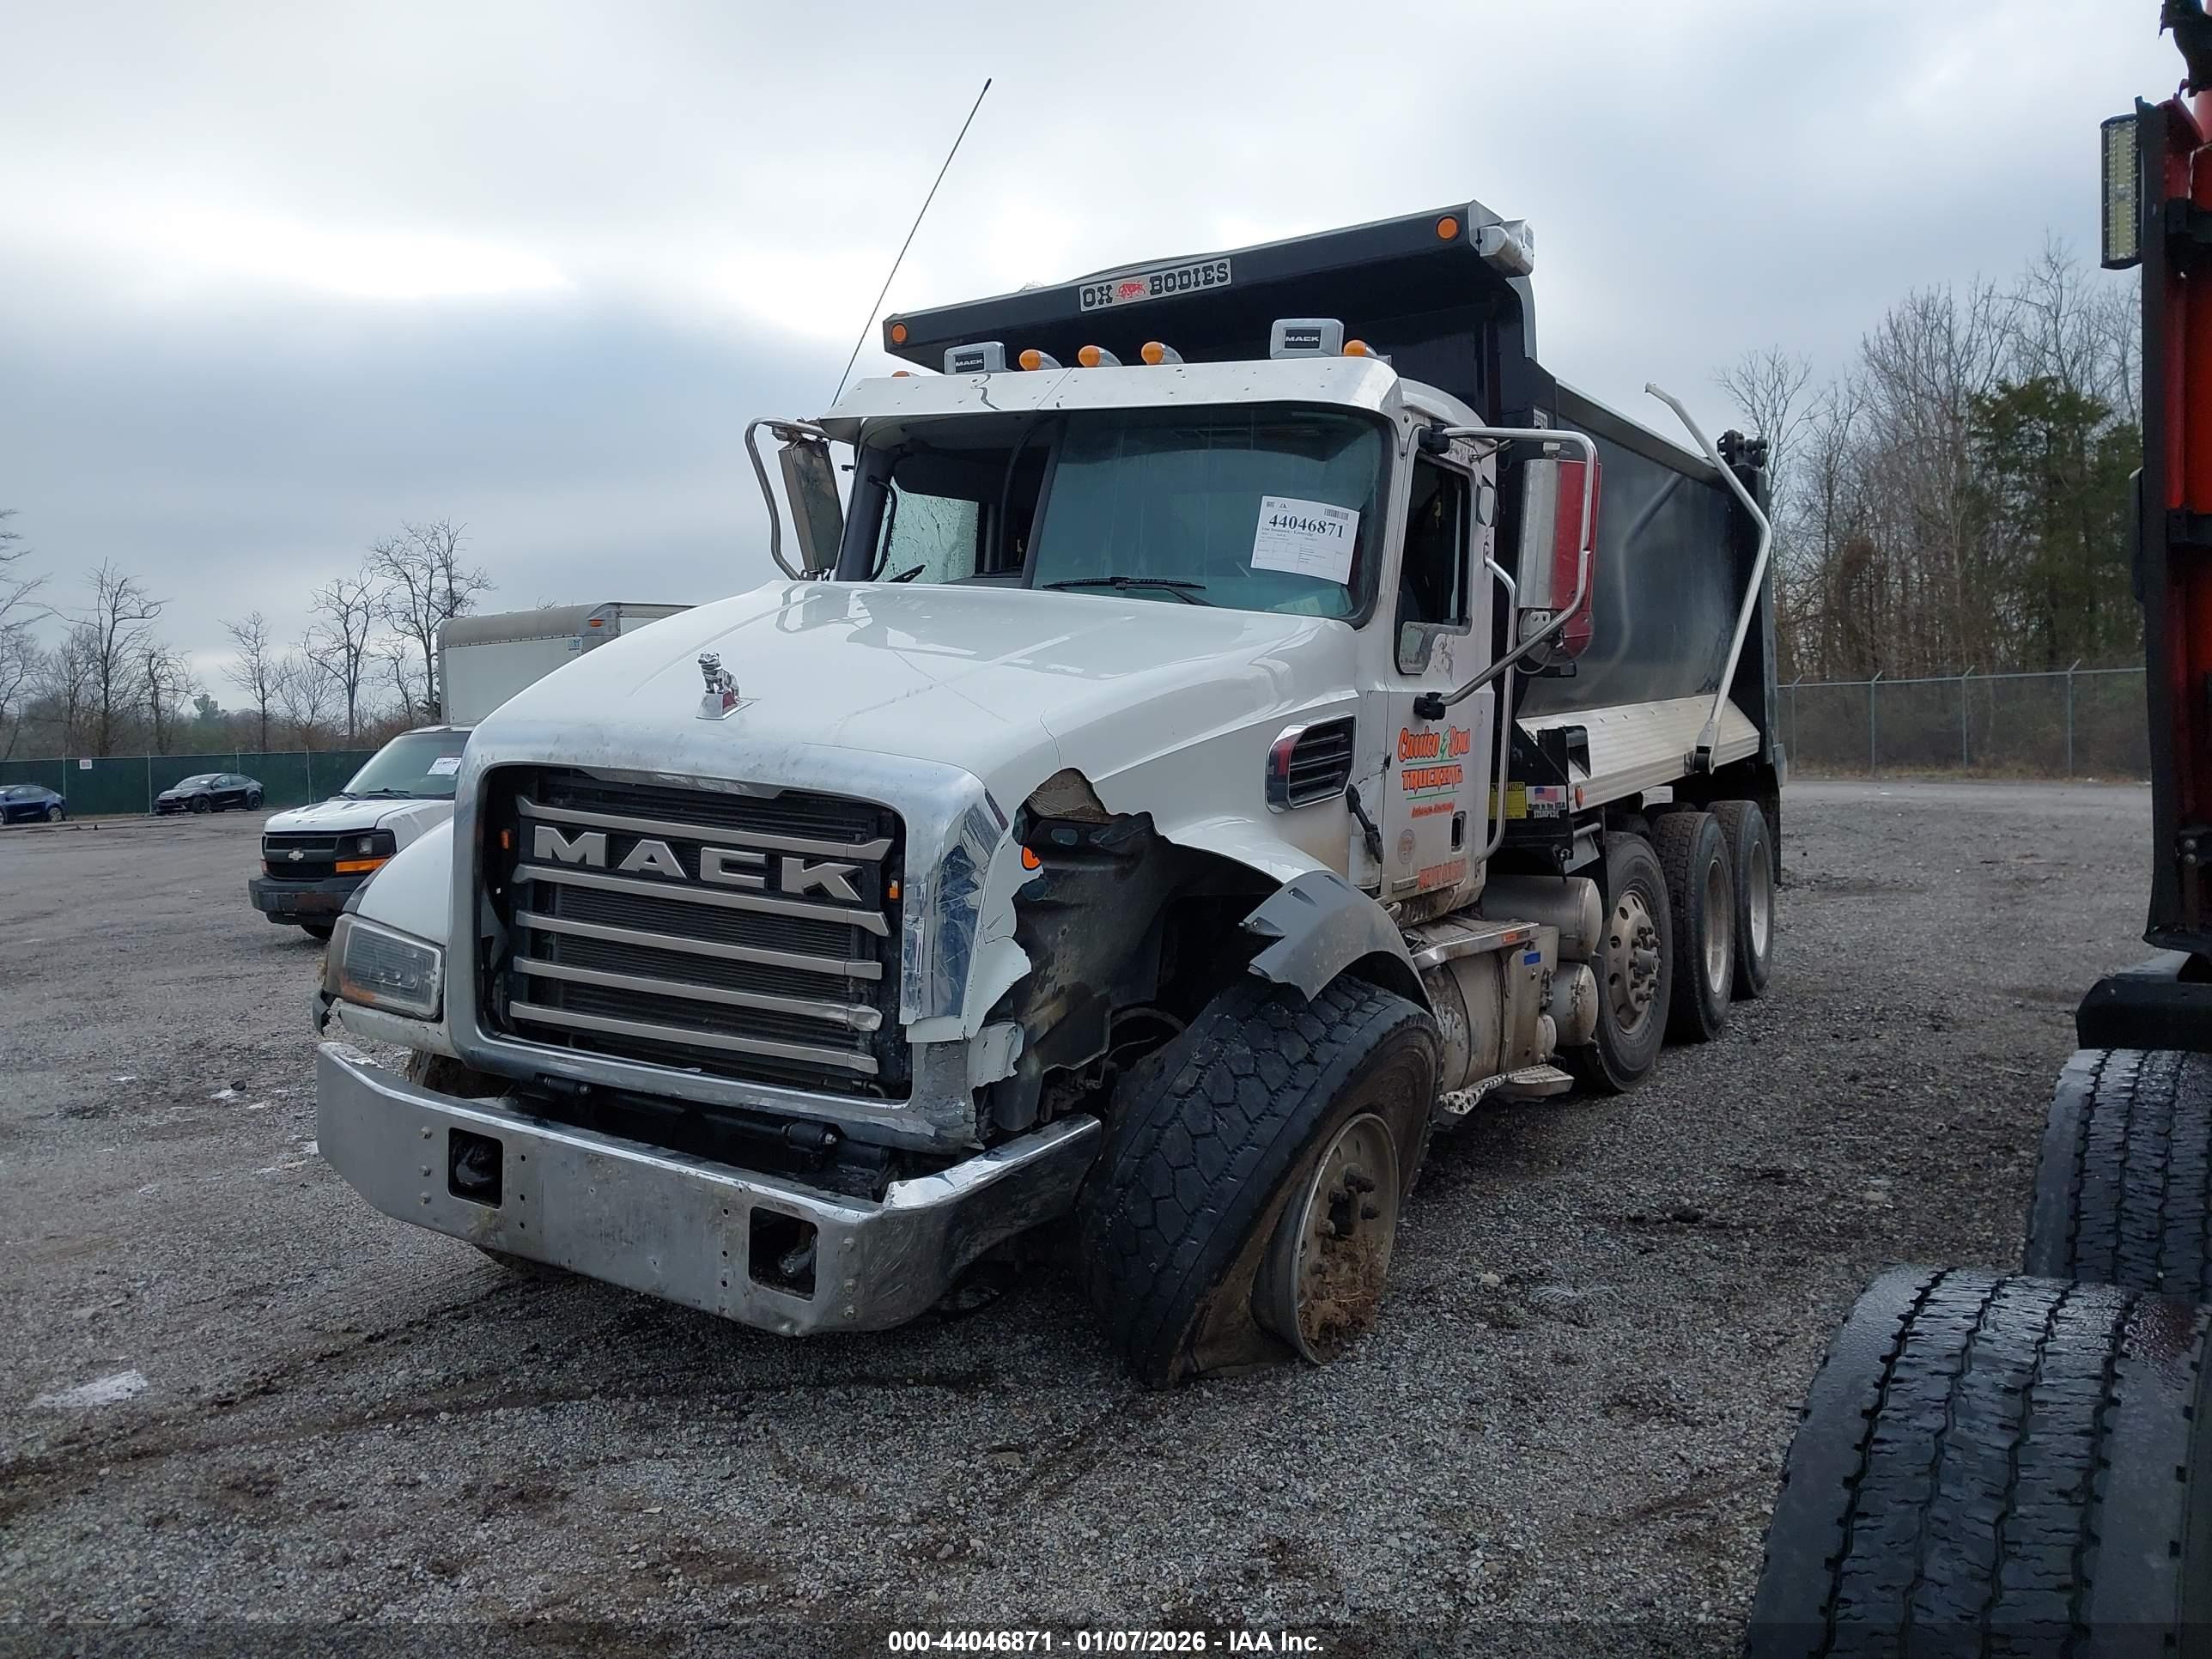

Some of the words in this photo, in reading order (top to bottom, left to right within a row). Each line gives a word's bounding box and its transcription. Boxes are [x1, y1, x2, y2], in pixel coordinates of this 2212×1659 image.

[1082, 284, 1113, 307] OX
[1149, 263, 1229, 296] BODIES
[955, 358, 983, 367] MACK
[1269, 514, 1345, 539] 44046871
[1401, 763, 1463, 795] TRUCKING
[533, 824, 862, 902] MACK
